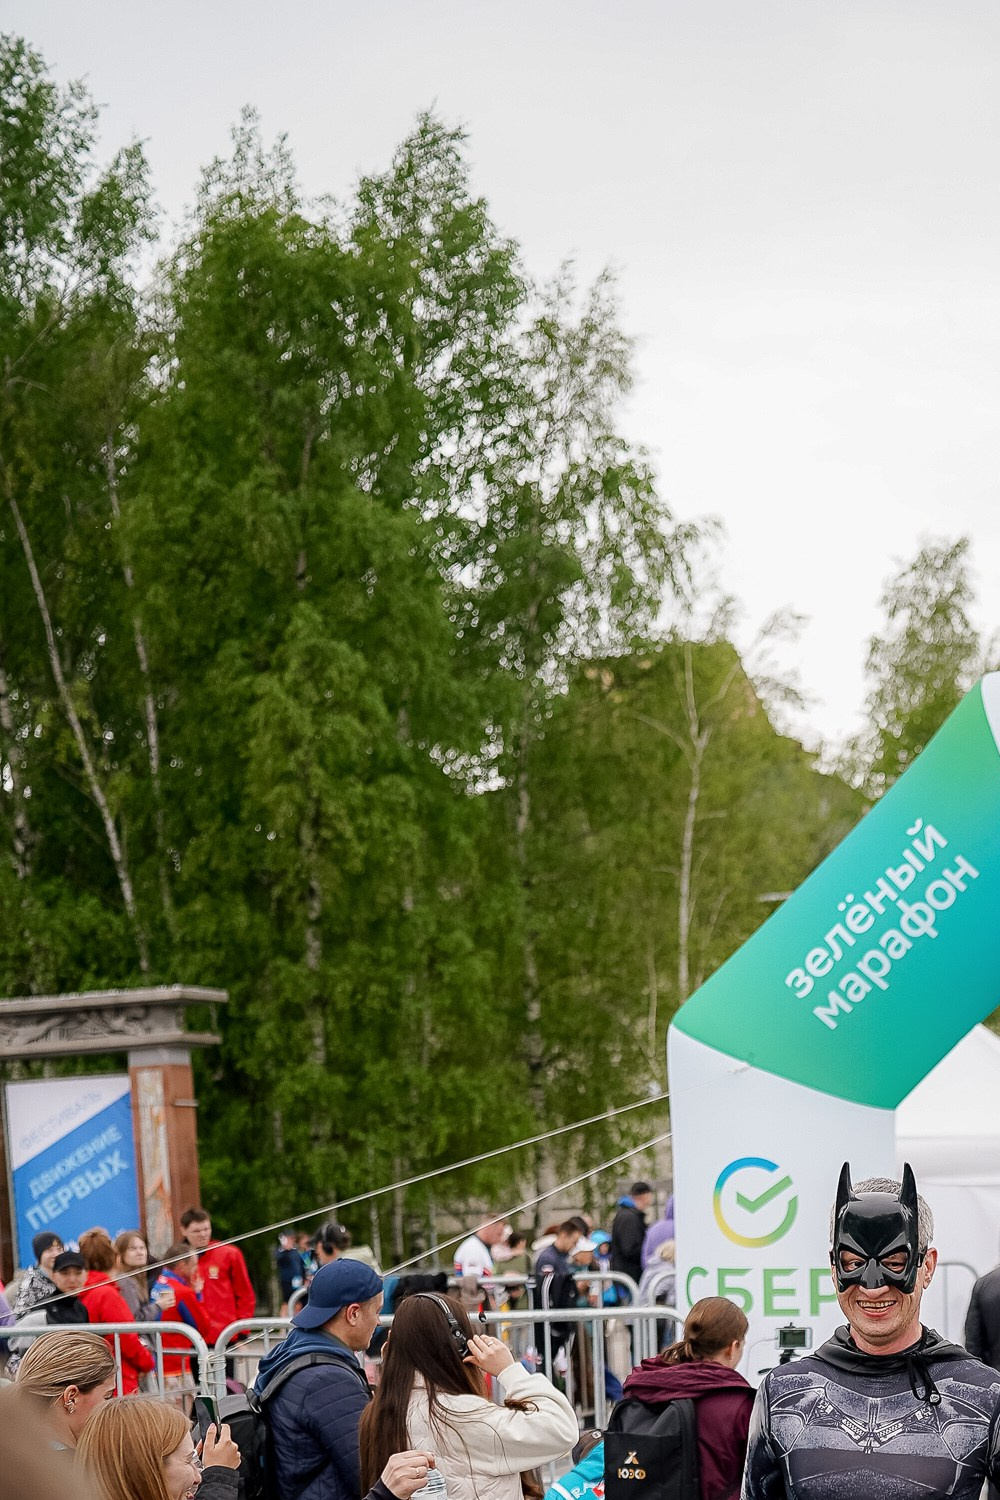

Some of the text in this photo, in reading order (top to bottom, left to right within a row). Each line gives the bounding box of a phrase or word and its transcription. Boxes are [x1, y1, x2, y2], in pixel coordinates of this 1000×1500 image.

[785, 817, 948, 999] зелёный
[813, 854, 980, 1030] марафон
[25, 1150, 129, 1231] ПЕРВЫХ
[29, 1123, 122, 1200] ДВИЖЕНИЕ
